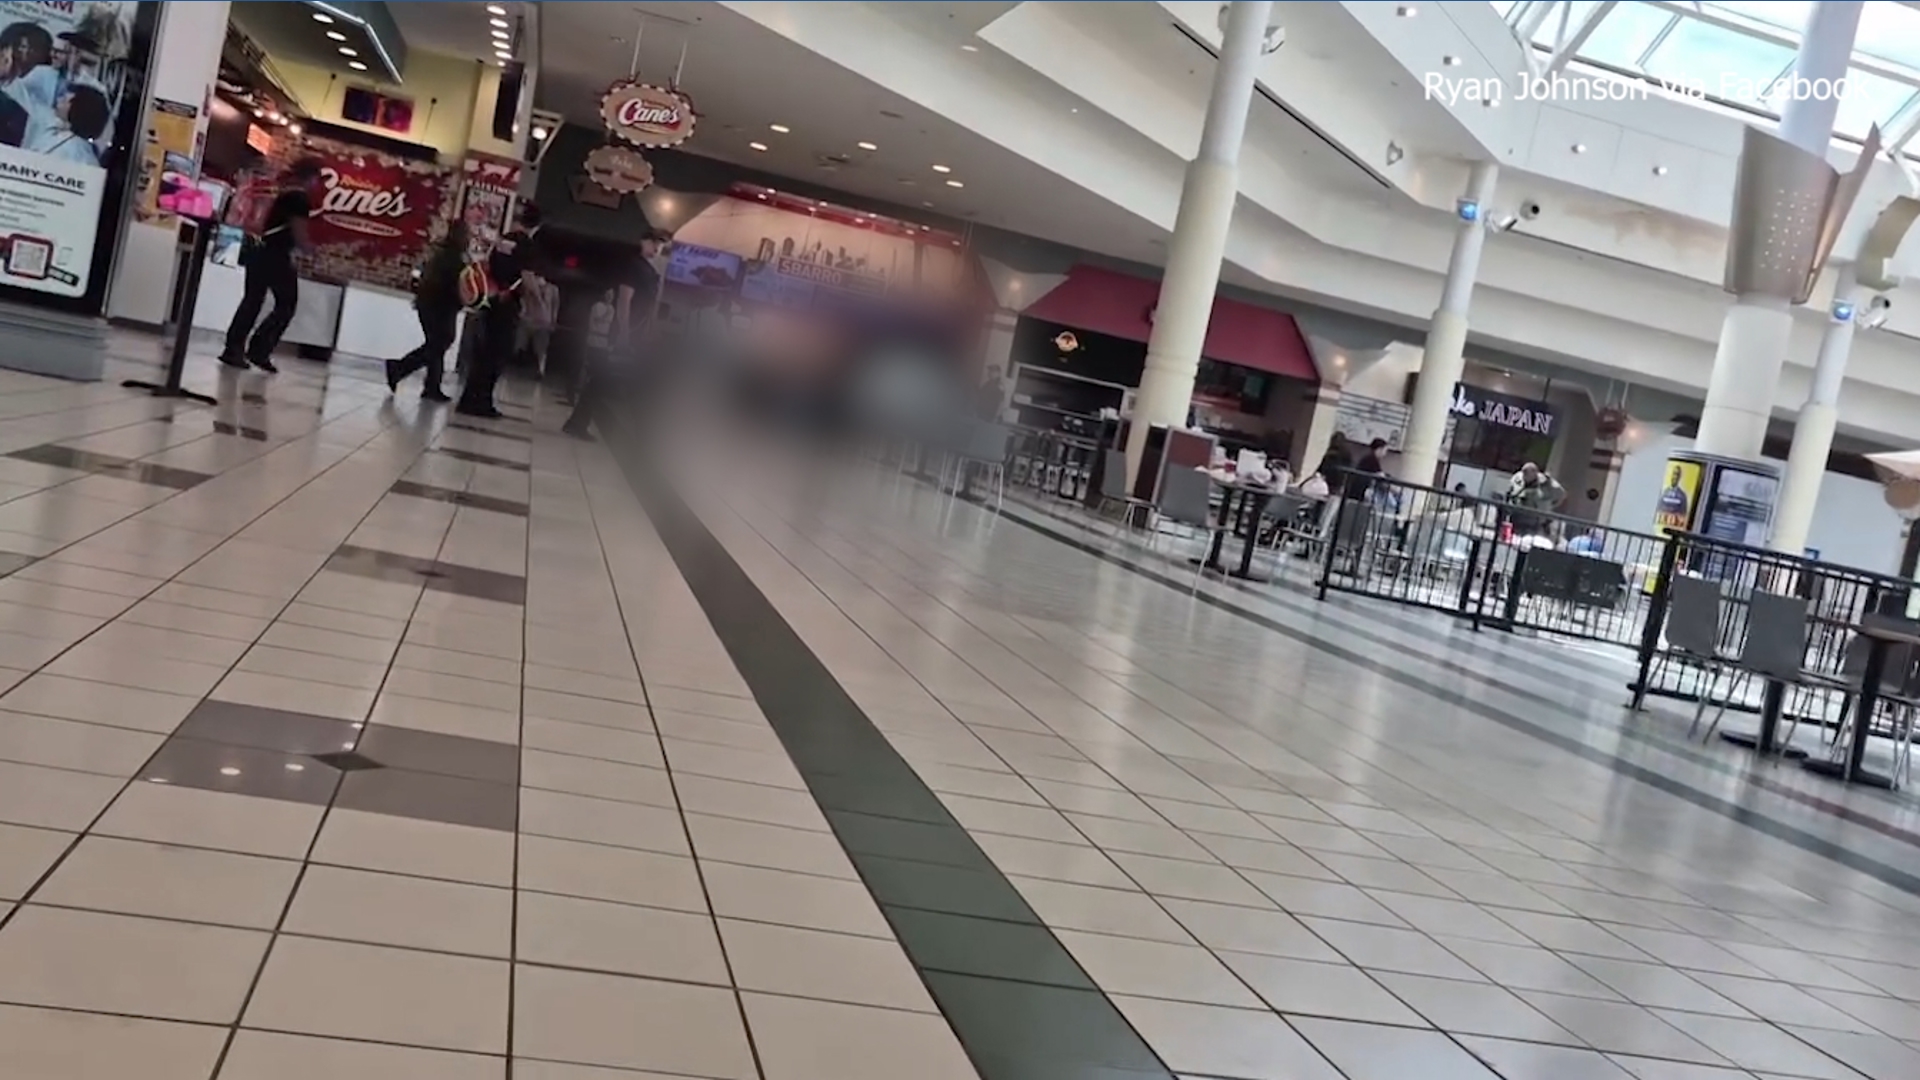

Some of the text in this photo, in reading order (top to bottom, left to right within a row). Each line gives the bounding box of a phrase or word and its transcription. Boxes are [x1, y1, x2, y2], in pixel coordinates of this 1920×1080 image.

[618, 97, 680, 125] Cane's
[44, 172, 87, 189] CARE
[780, 260, 842, 285] SBARRO
[1478, 400, 1553, 435] JAPAN
